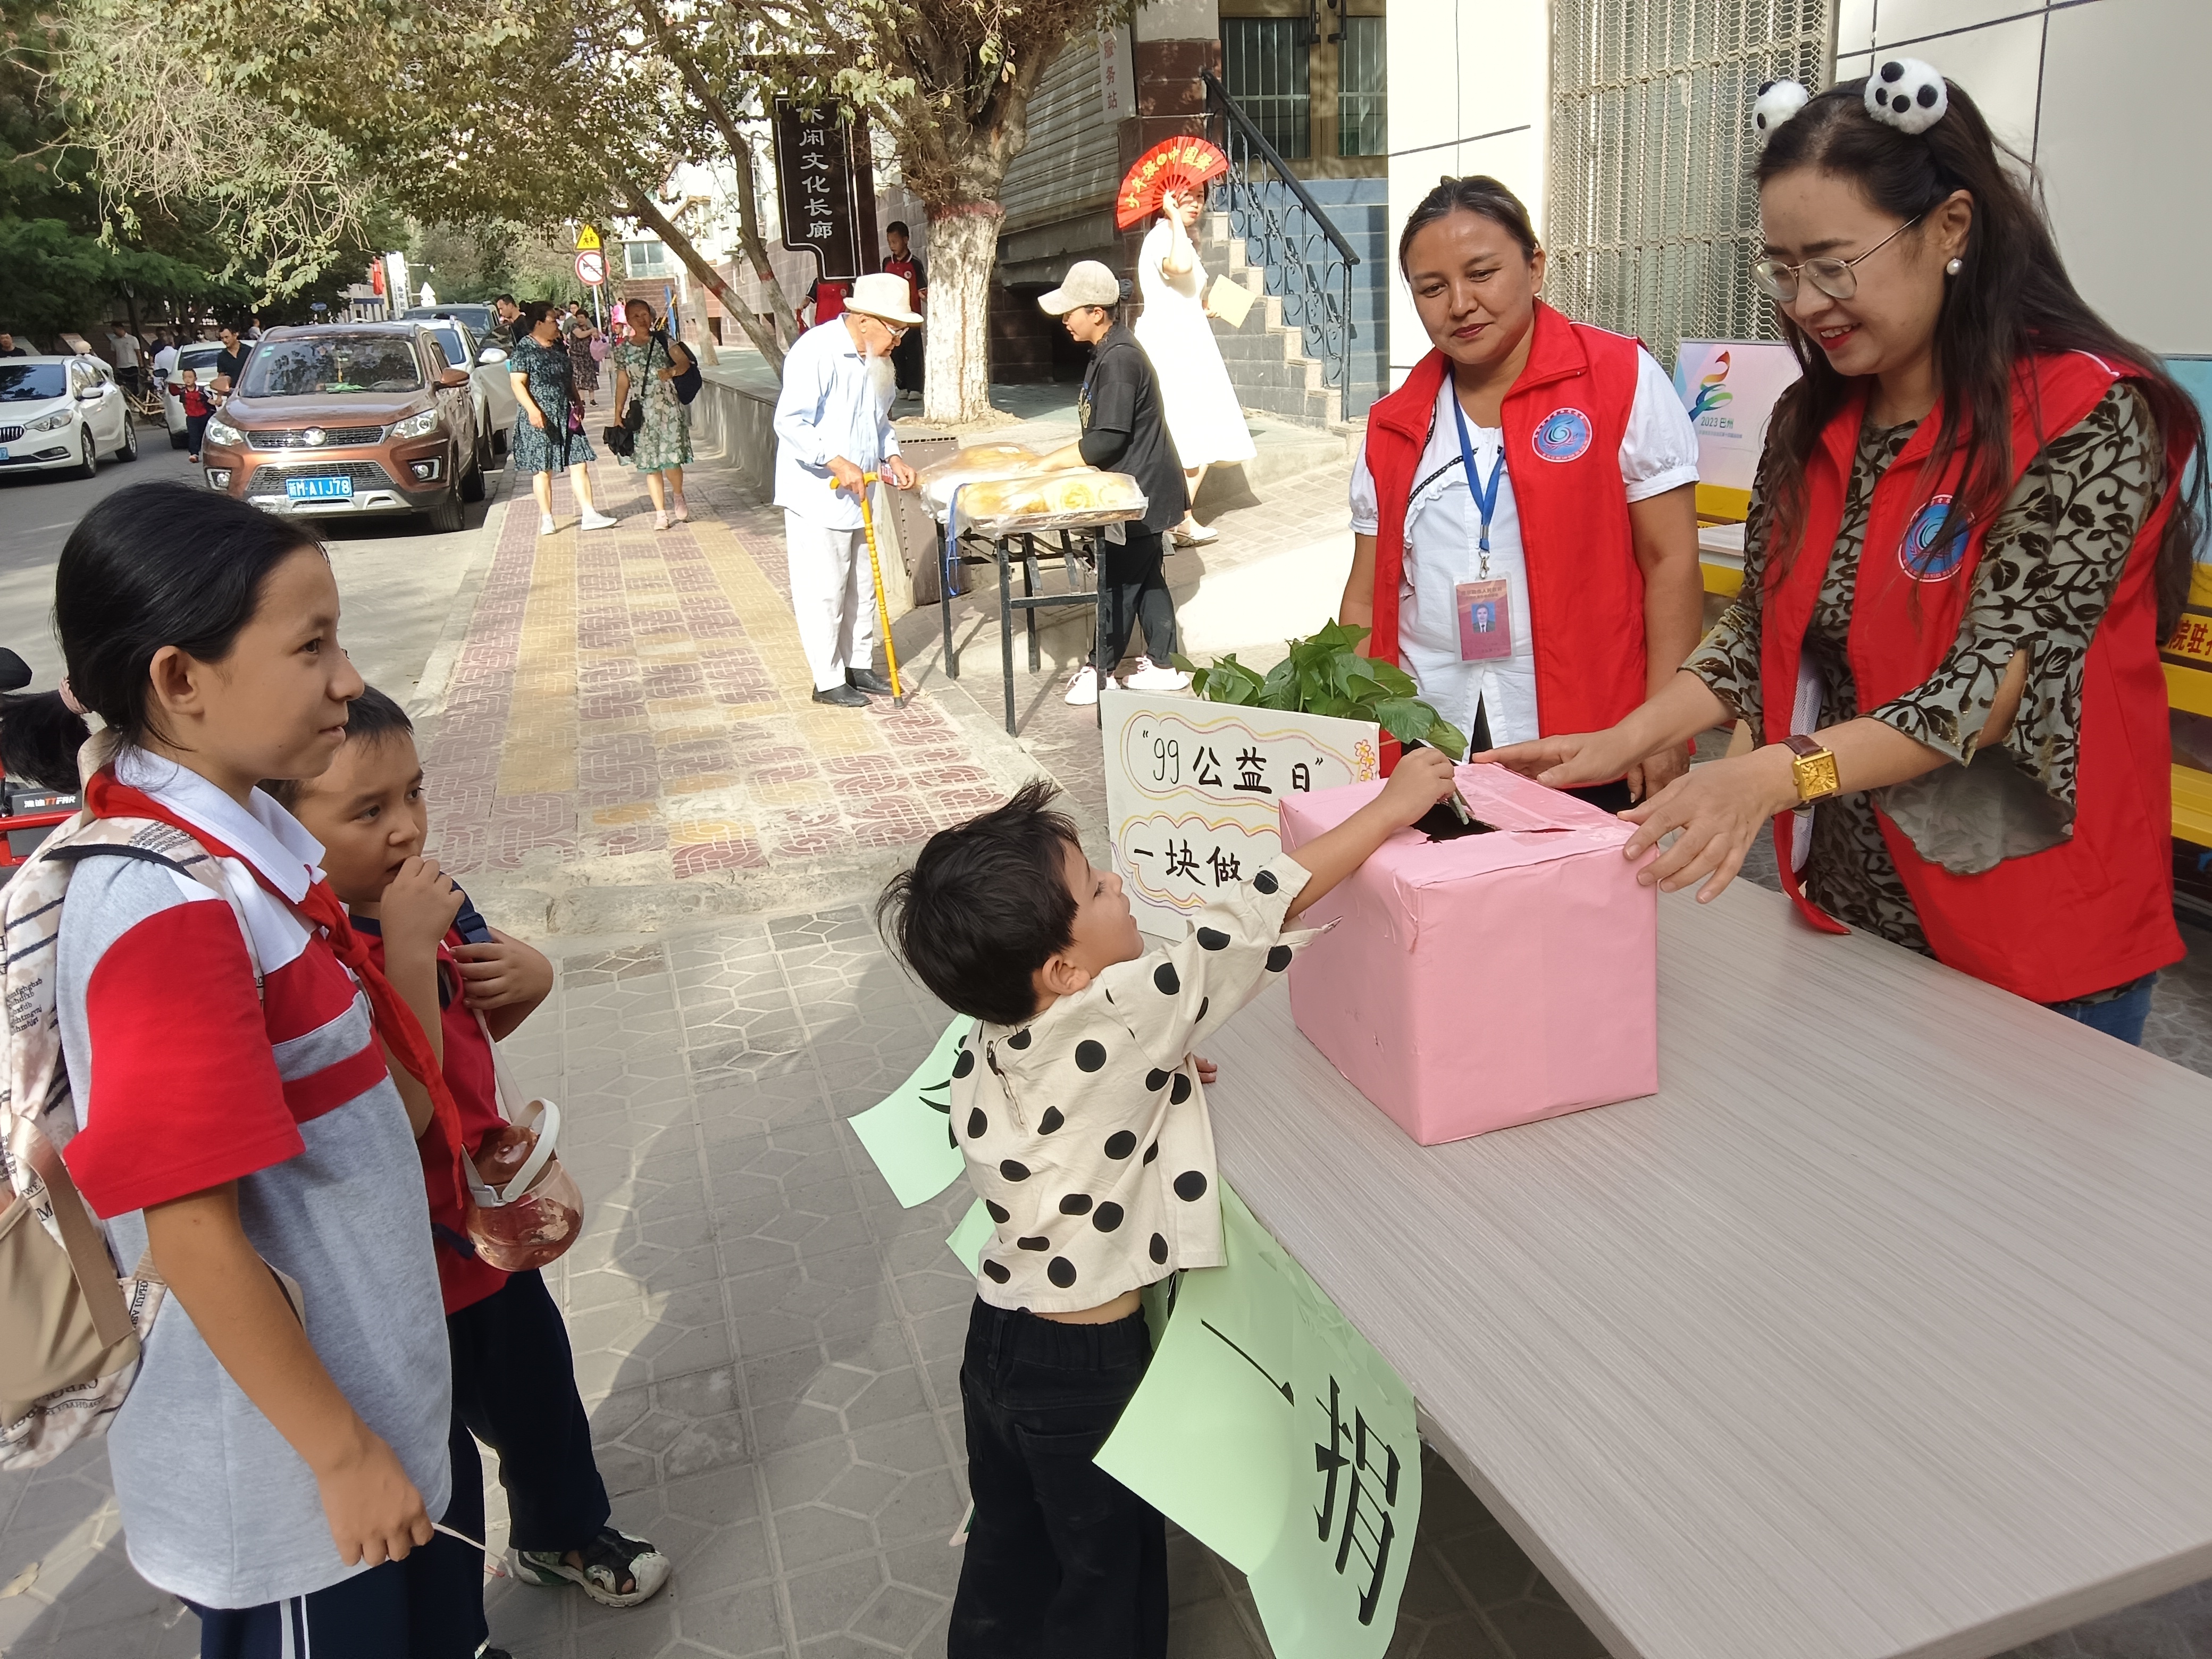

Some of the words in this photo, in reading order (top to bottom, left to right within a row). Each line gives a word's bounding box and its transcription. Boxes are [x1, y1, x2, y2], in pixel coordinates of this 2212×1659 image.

[795, 106, 833, 239] 休闲文化长廊
[1701, 416, 1718, 427] 2023
[1720, 417, 1734, 429] 巴州
[1134, 839, 1273, 887] 一块做
